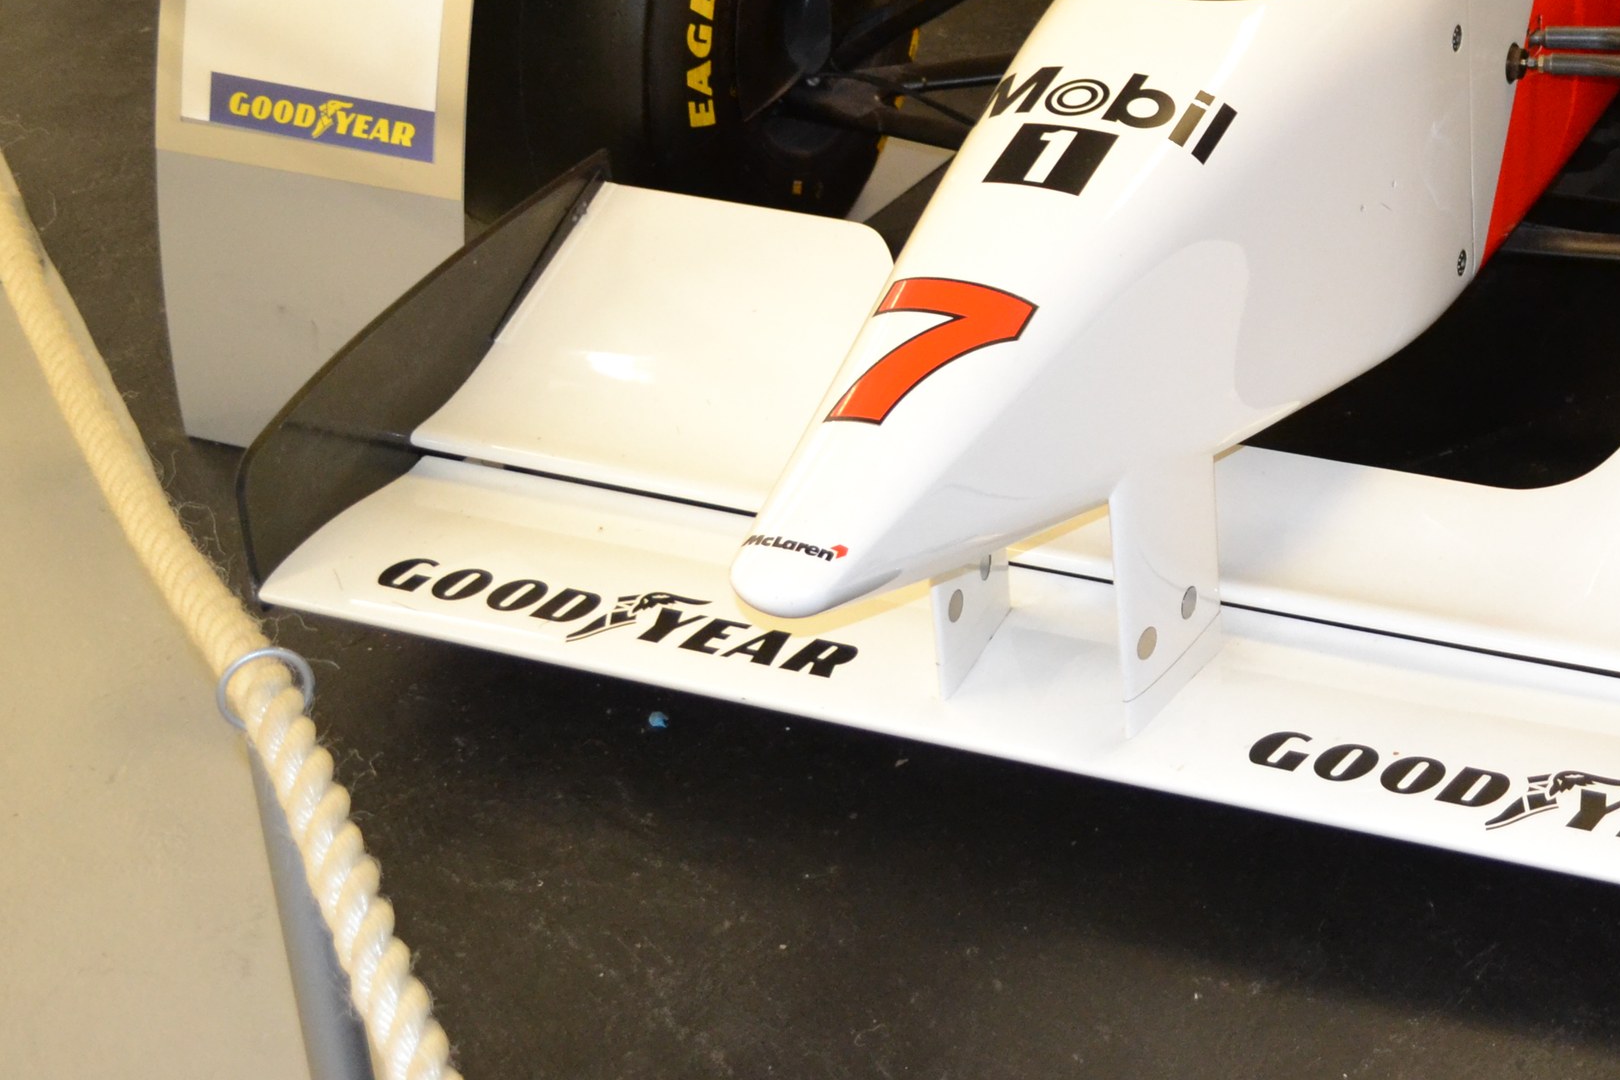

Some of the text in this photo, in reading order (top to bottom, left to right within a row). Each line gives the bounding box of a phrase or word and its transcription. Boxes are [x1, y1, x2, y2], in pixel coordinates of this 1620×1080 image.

[229, 91, 416, 148] GOODYEAR
[988, 66, 1239, 166] Mobil
[822, 276, 1040, 426] 7
[742, 534, 835, 562] McLaren
[377, 557, 859, 679] GOODYEAR
